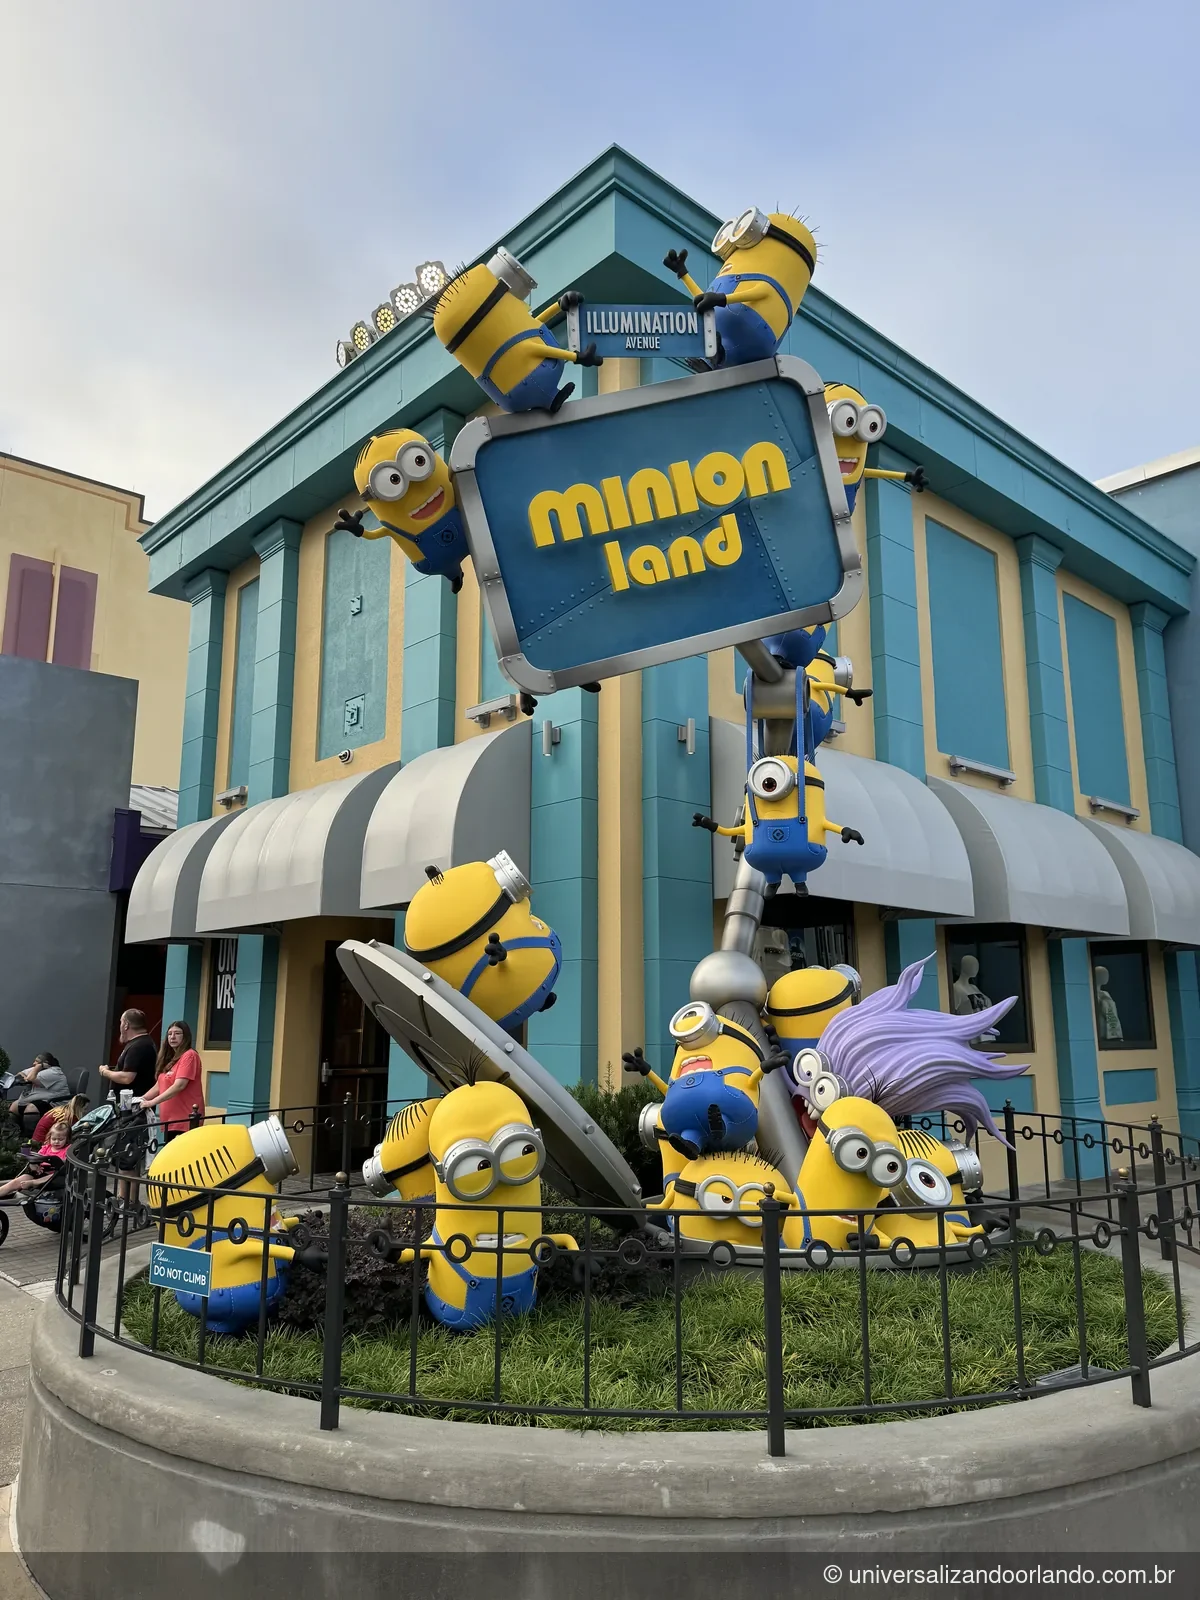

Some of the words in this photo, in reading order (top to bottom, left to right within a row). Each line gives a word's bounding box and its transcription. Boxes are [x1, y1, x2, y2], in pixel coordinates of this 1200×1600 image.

[586, 311, 698, 334] ILLUMINATION
[625, 337, 661, 349] AVENUE
[604, 513, 742, 592] land
[154, 1265, 165, 1276] DO
[167, 1268, 182, 1280] NOT
[183, 1271, 206, 1286] CLIMB
